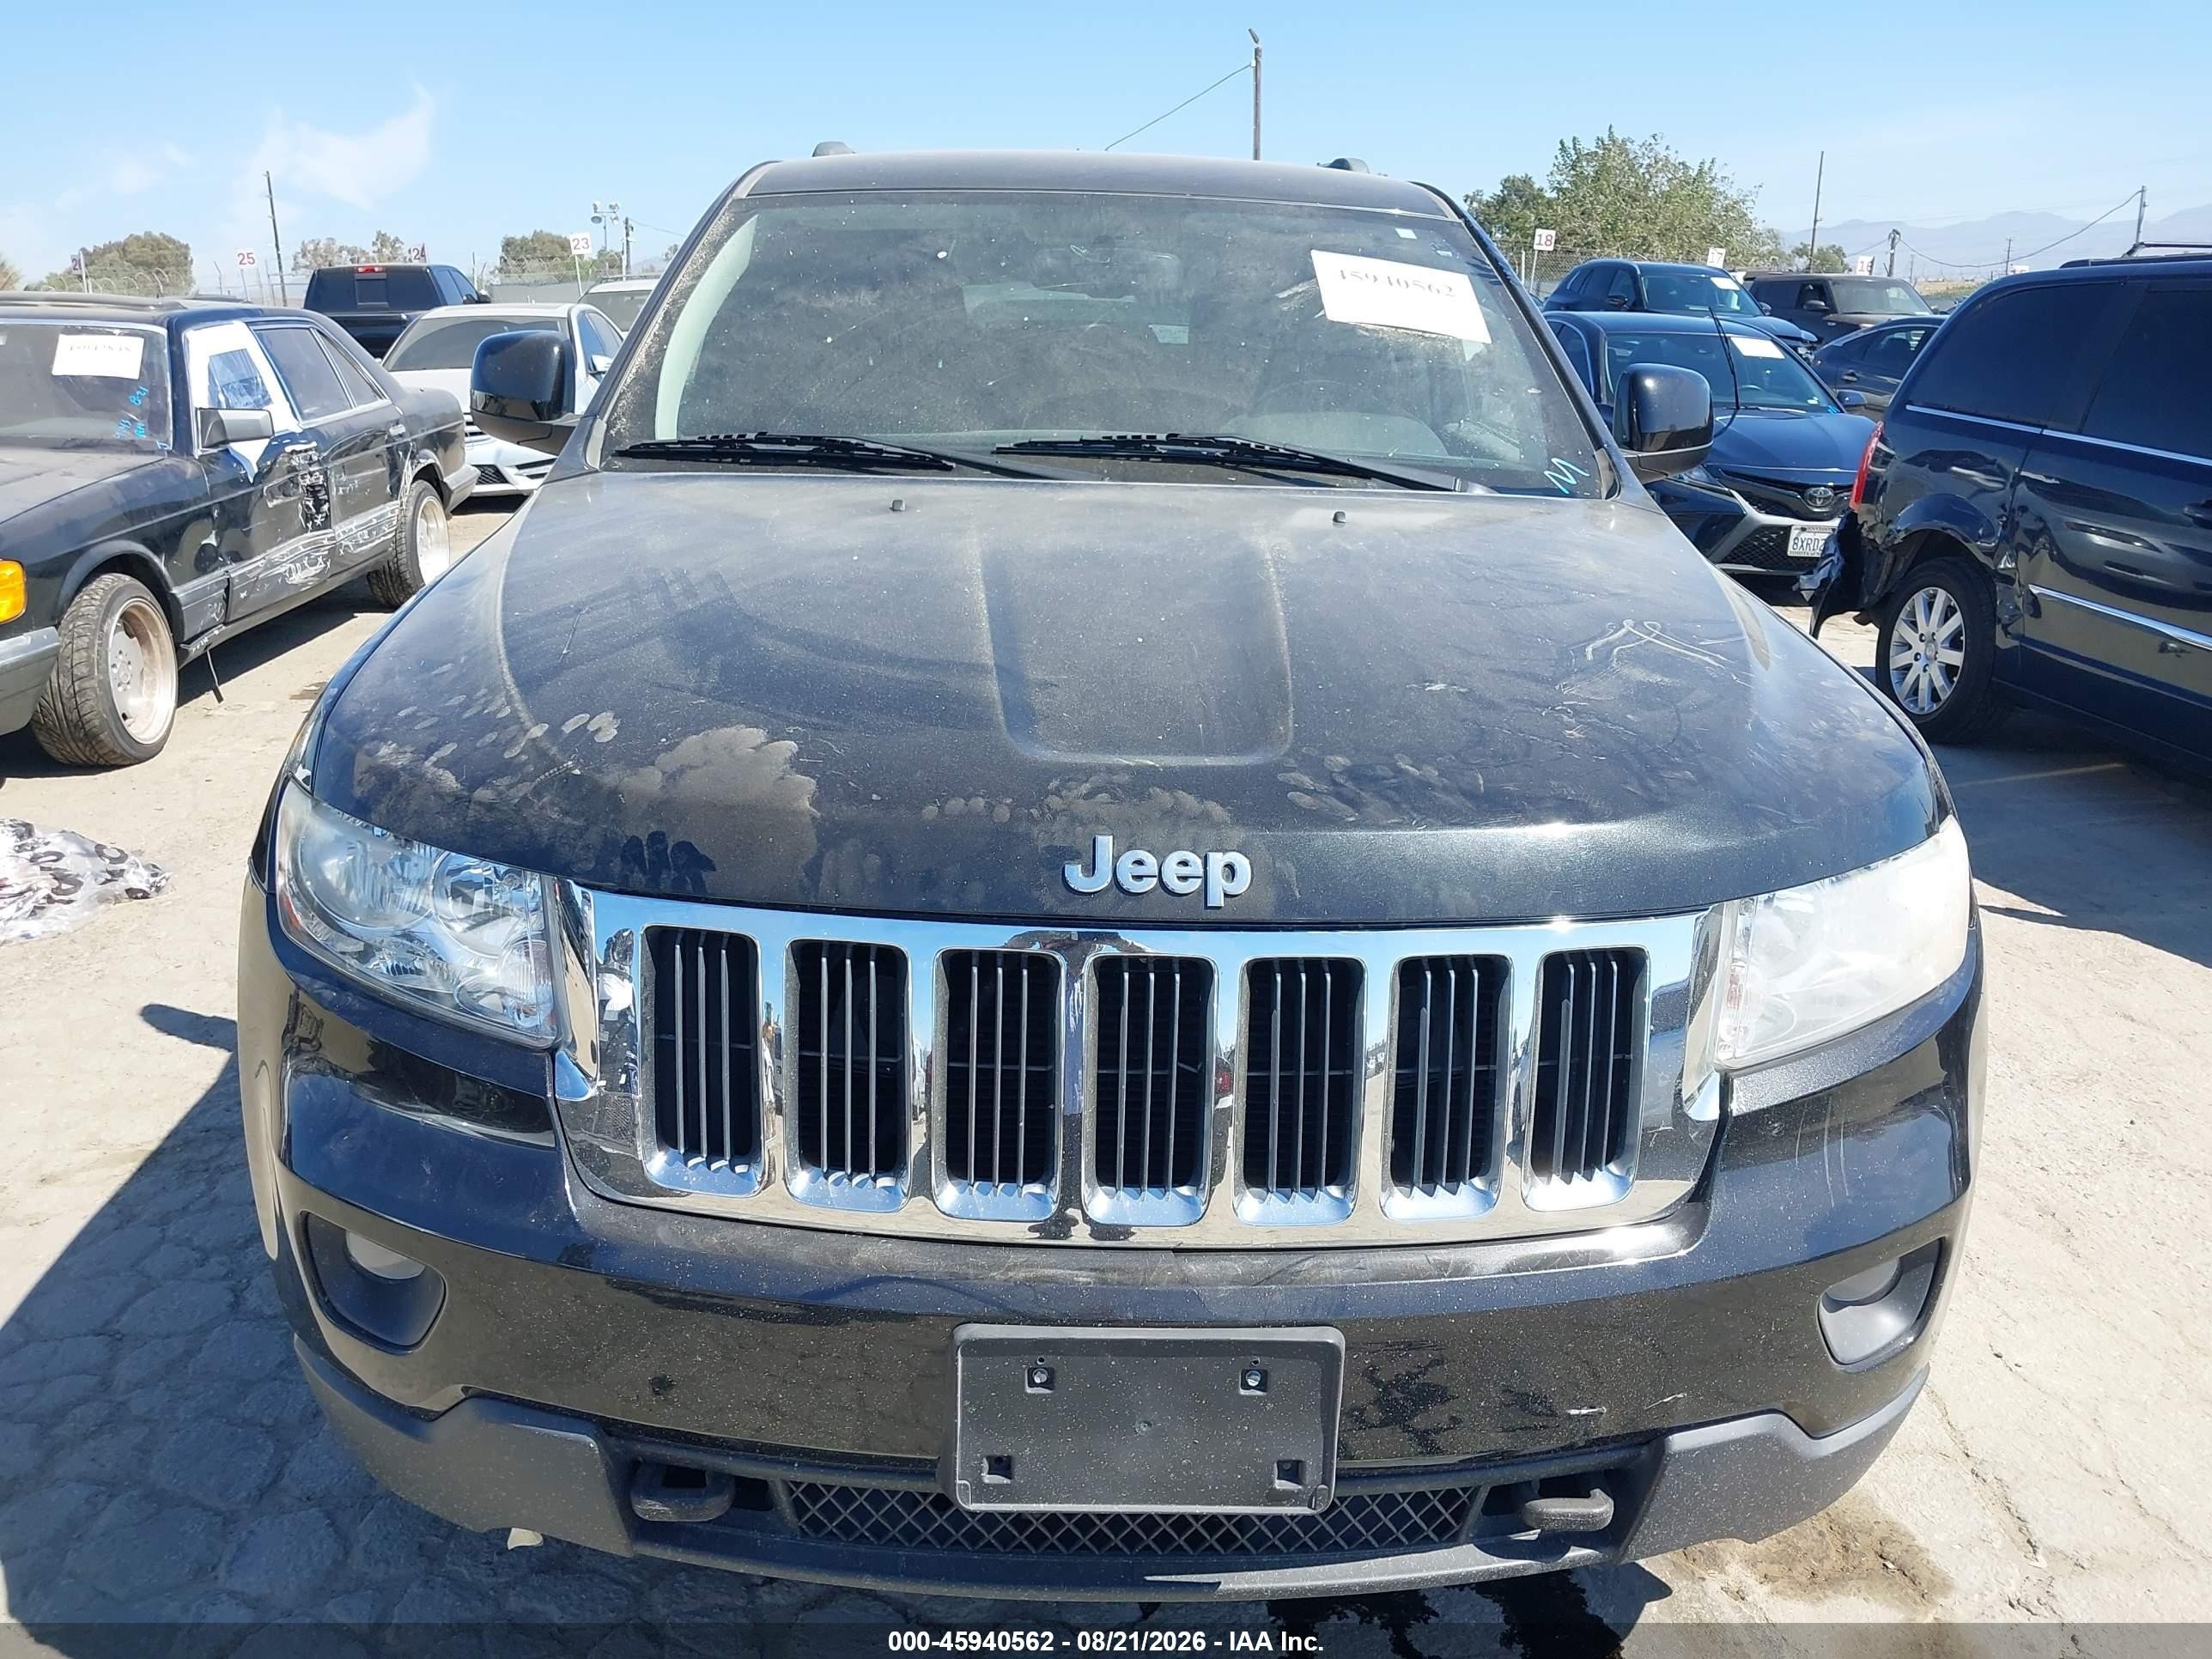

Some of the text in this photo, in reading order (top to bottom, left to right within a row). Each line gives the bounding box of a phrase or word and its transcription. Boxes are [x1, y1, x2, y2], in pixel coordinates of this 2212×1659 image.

[572, 237, 590, 250] 23
[1535, 234, 1553, 246] 18
[237, 252, 255, 265] 25
[412, 246, 426, 260] 24
[1709, 252, 1723, 264] 17
[1063, 835, 1253, 908] Jeep
